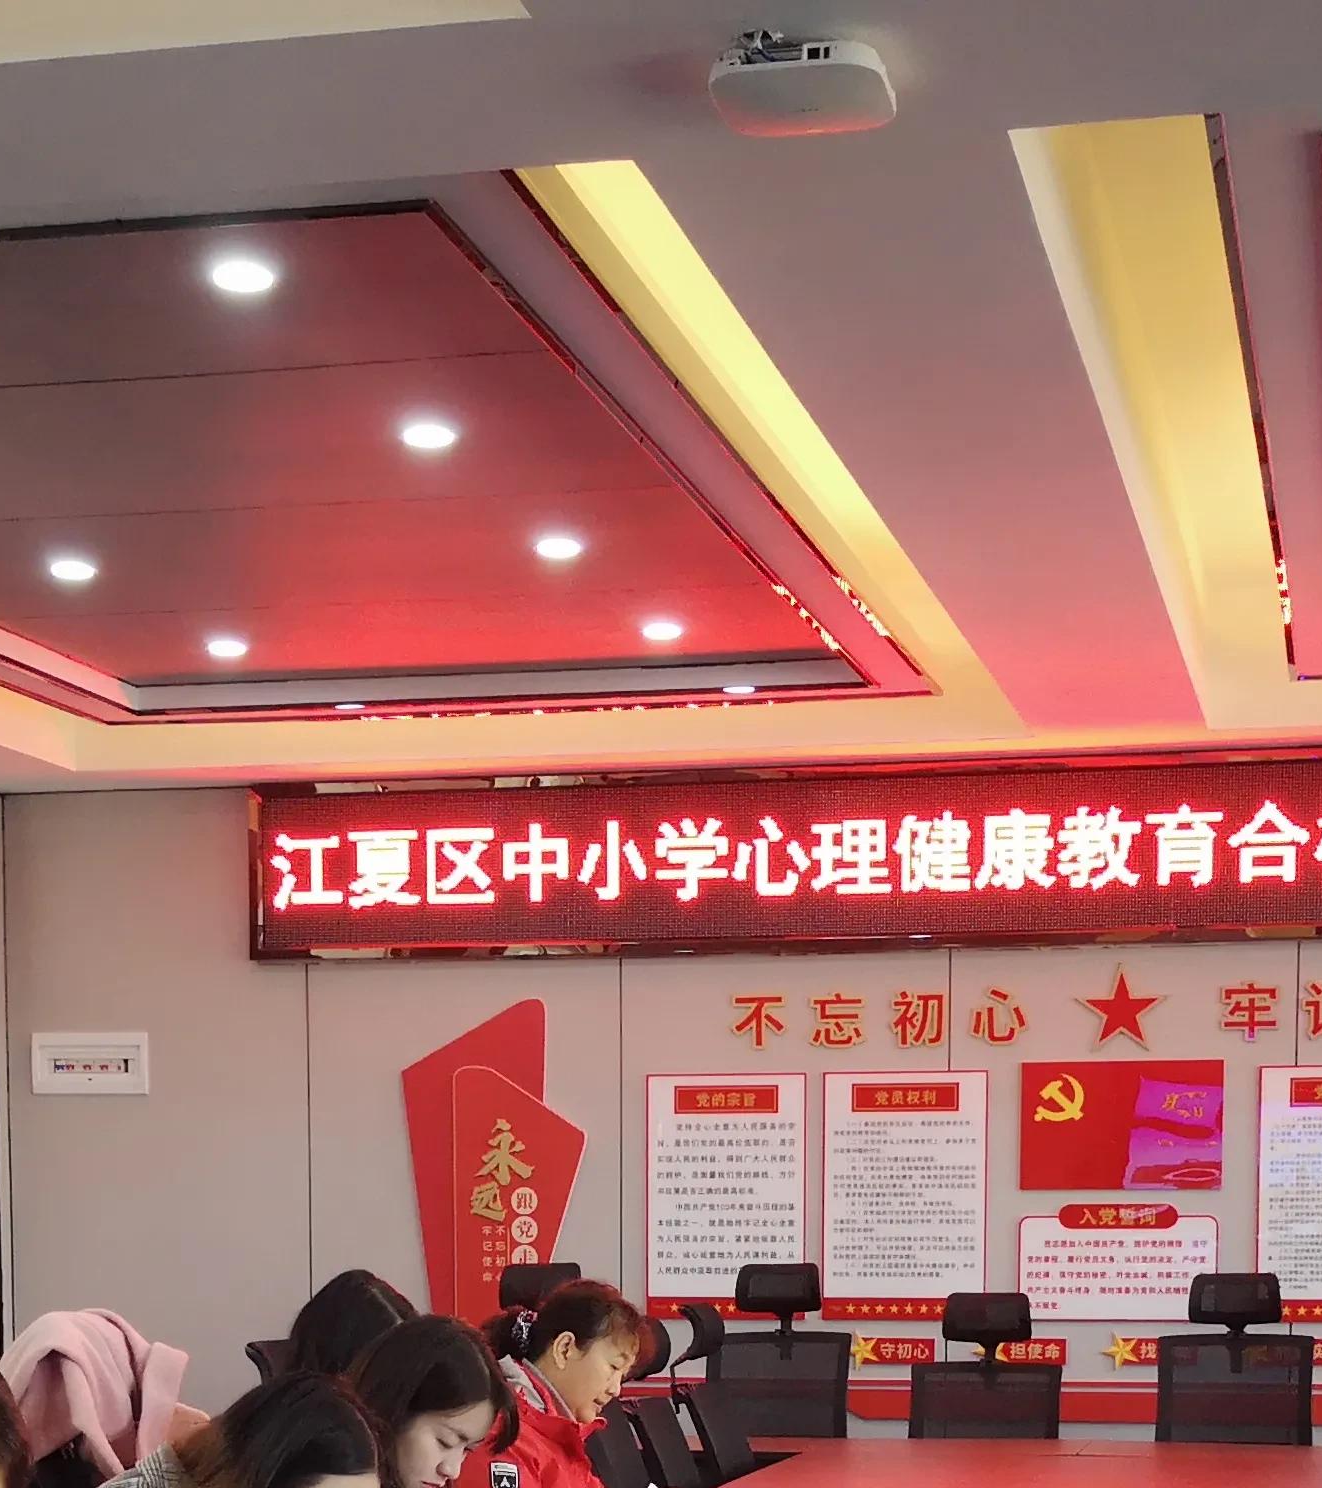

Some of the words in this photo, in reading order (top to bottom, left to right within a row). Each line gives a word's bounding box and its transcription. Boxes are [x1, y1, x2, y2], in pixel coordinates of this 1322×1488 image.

[733, 989, 1027, 1048] 不忘初心
[696, 1092, 757, 1108] 党的宗旨
[874, 1090, 937, 1106] 党员权利
[1079, 1207, 1157, 1227] 入党誓词
[880, 1341, 930, 1361] 守初心
[1009, 1342, 1062, 1361] 担使命
